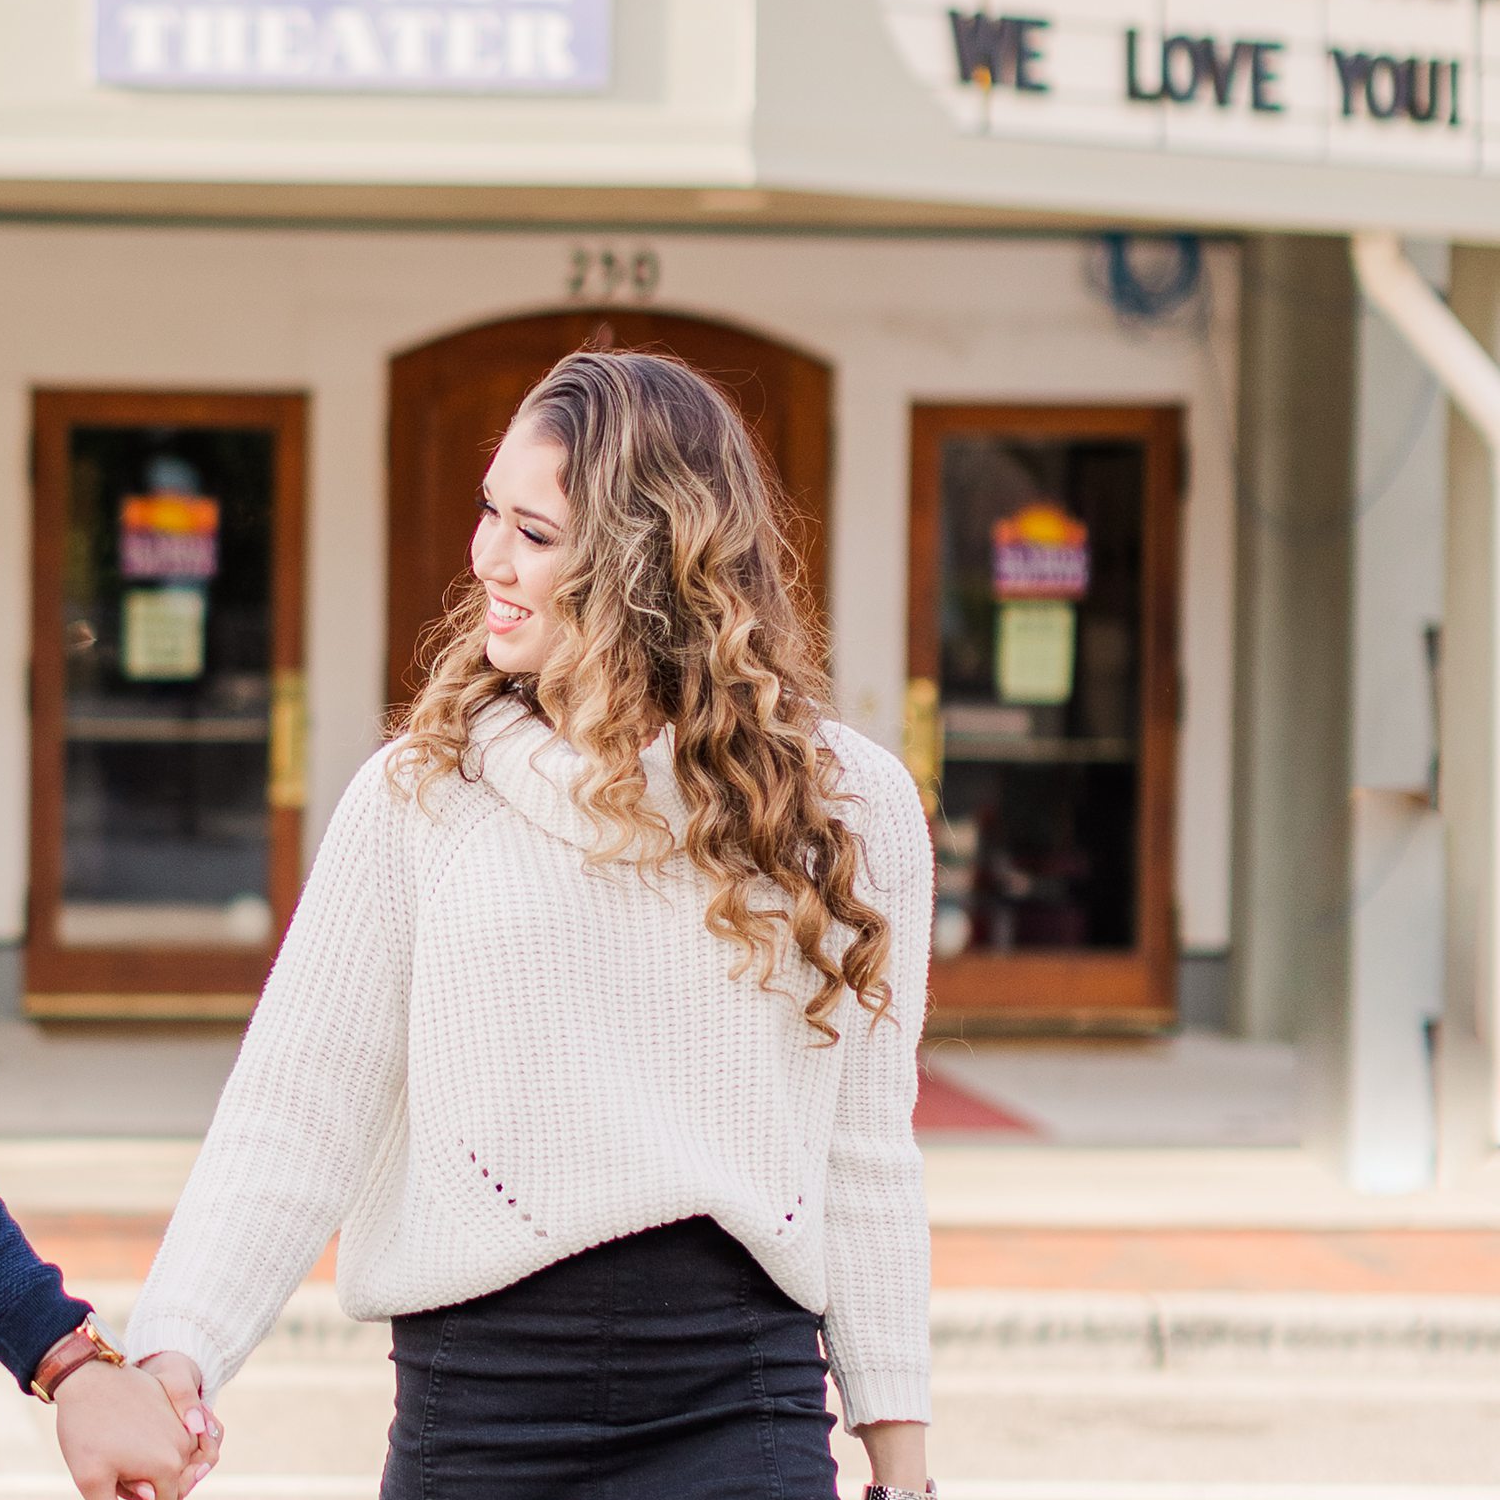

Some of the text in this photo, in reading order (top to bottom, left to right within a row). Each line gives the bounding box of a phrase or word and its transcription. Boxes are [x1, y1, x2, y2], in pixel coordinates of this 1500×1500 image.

[118, 5, 577, 79] THEATER
[947, 10, 1460, 127] WE LOVE YOU!
